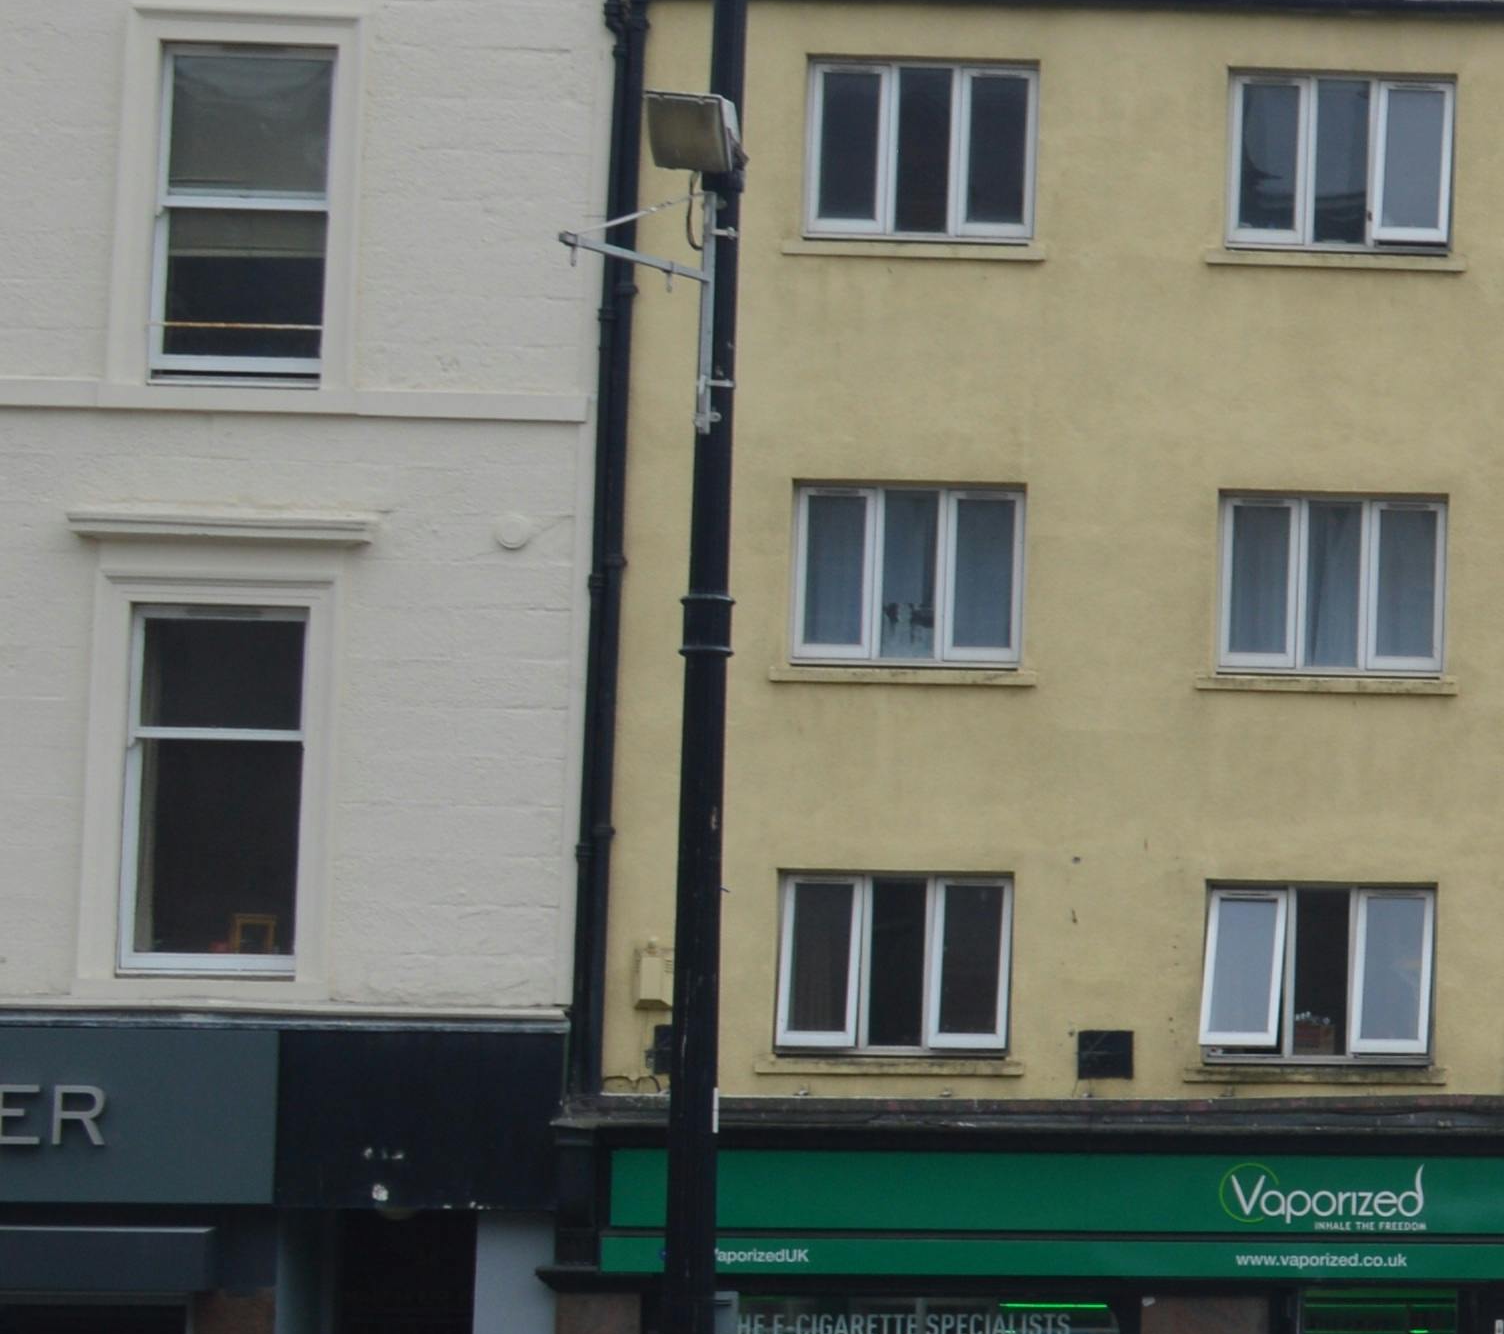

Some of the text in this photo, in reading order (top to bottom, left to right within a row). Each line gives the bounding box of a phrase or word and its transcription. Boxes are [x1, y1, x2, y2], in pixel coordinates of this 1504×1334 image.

[0, 1084, 105, 1145] ER
[1231, 1164, 1425, 1224] Vaporized
[1314, 1222, 1426, 1231] INHALE THE FREEDOM
[1236, 1253, 1408, 1270] www.vaporized.co.uk
